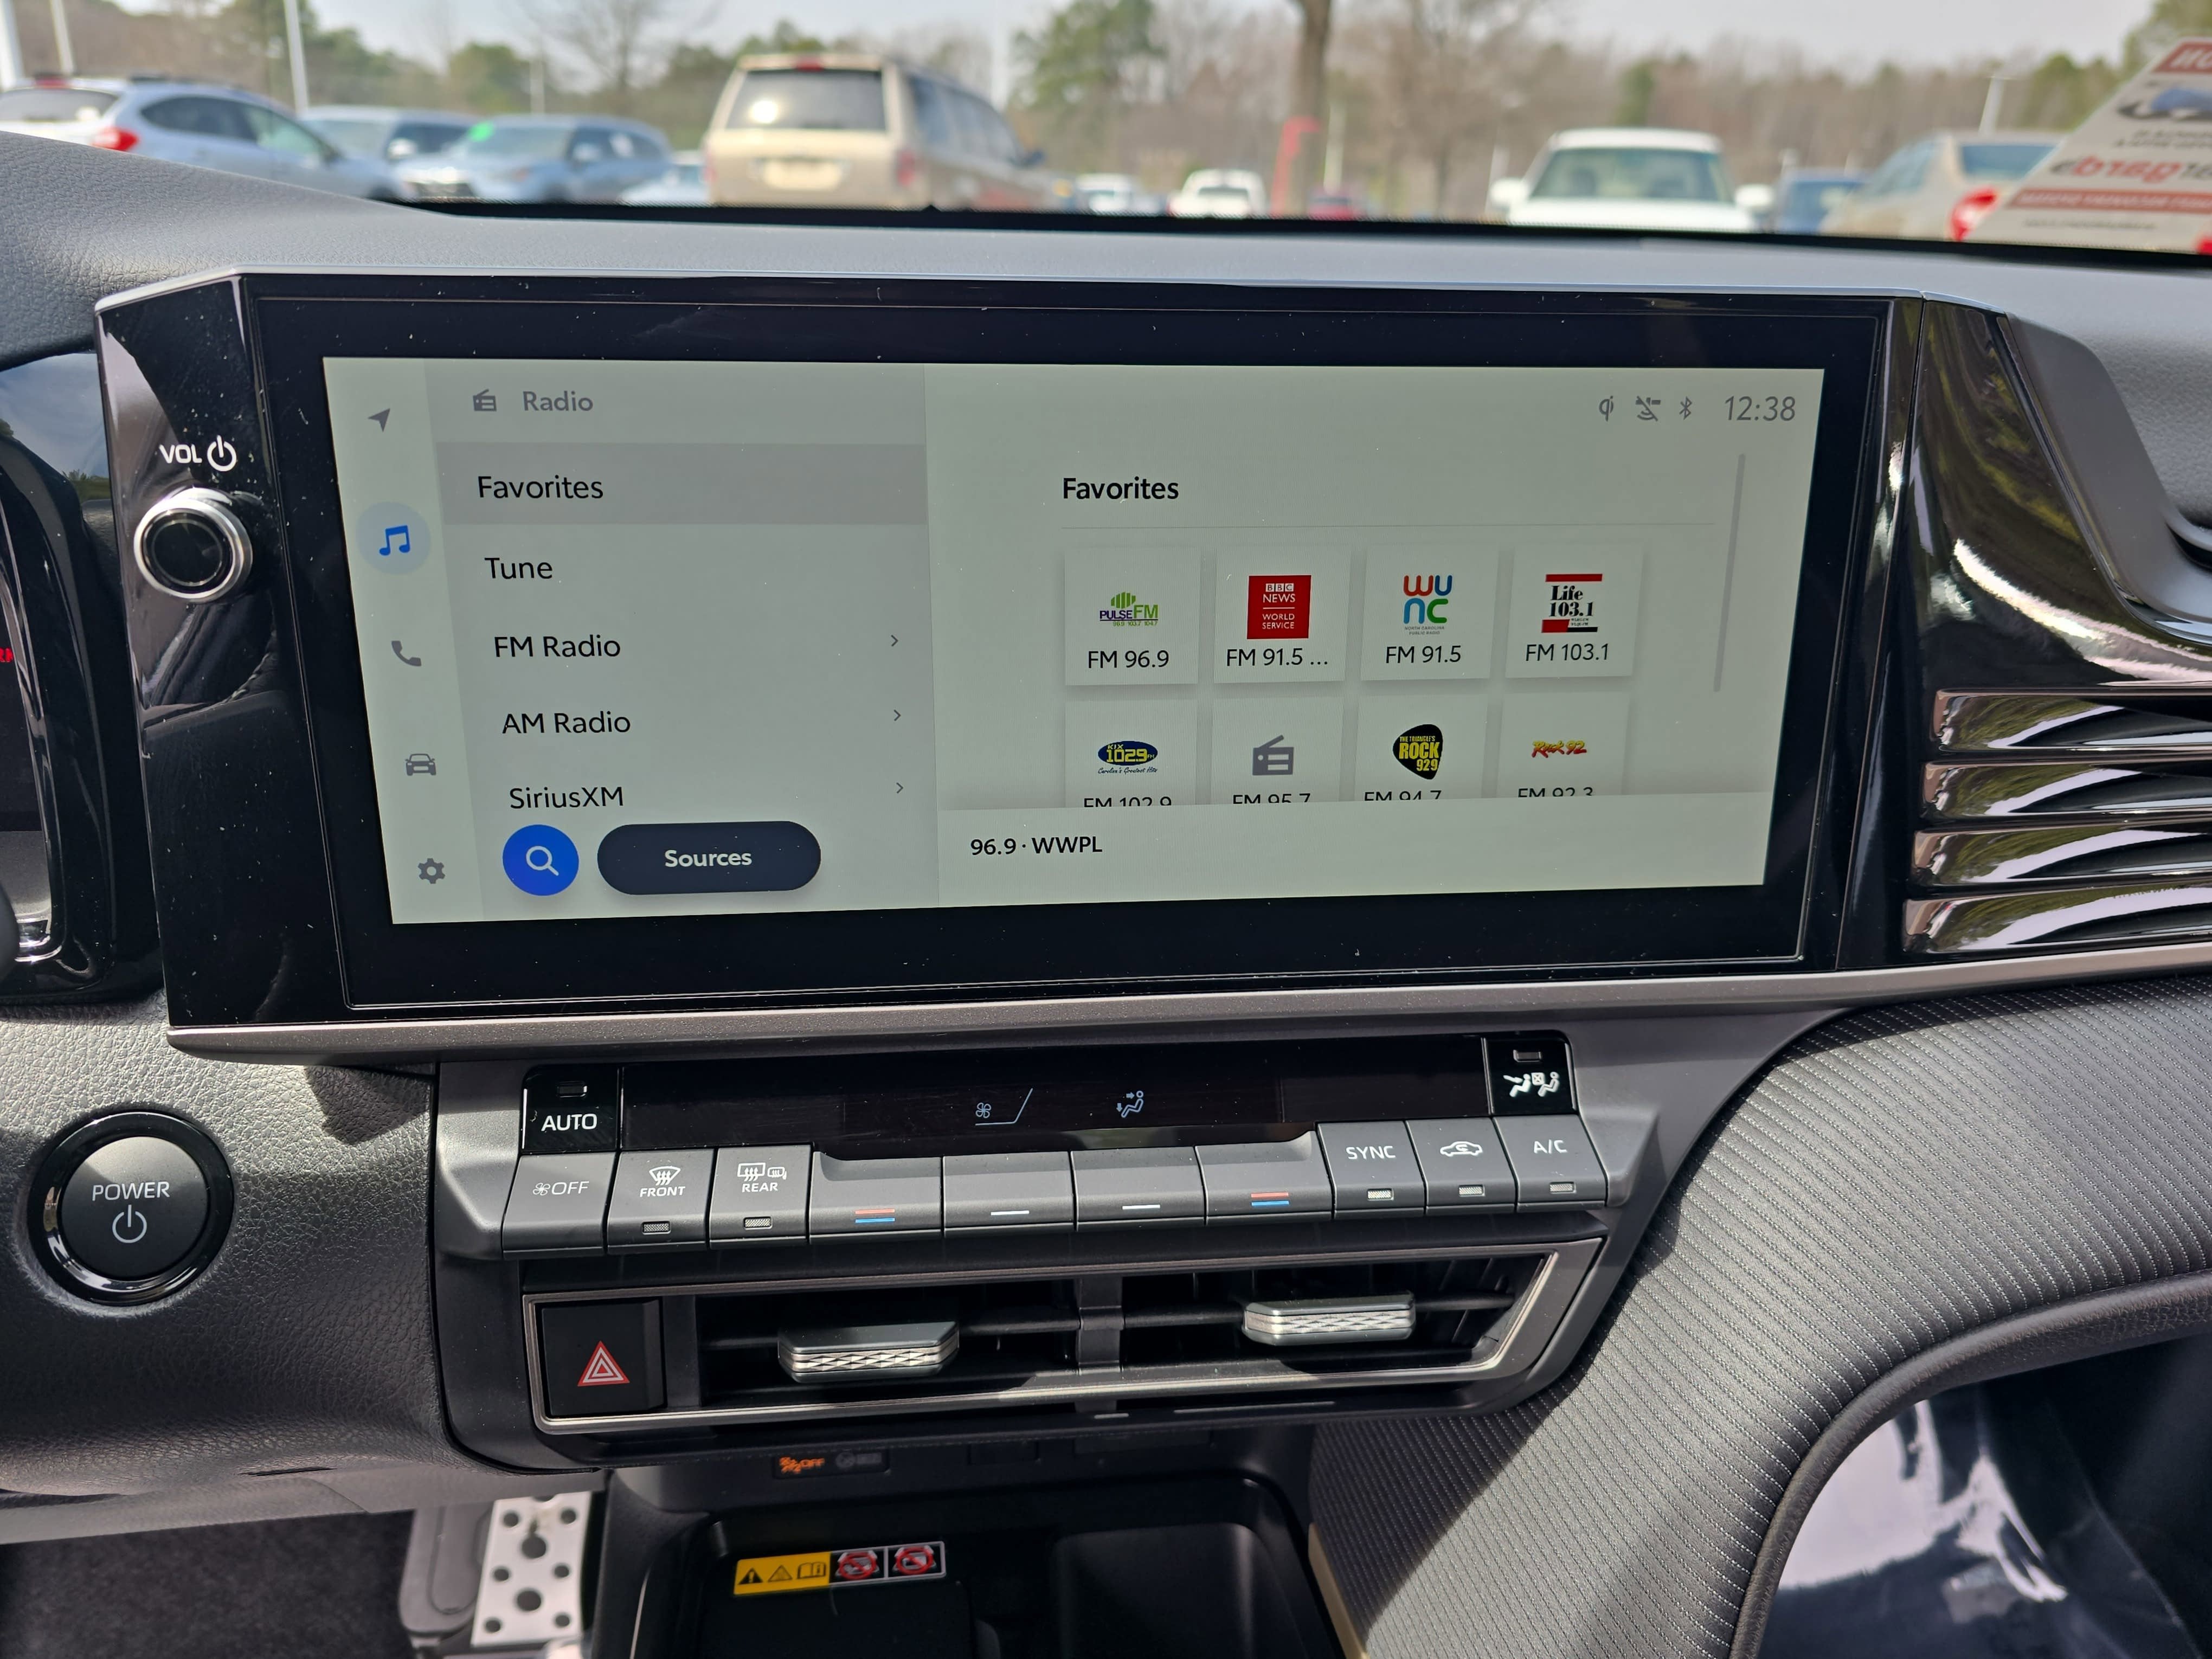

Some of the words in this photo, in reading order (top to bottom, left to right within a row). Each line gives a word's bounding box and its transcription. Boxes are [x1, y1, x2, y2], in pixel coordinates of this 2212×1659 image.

[523, 390, 594, 411] Radio
[1725, 396, 1796, 421] 12:38
[159, 445, 202, 464] VOL
[478, 475, 603, 499] Favorites
[1063, 476, 1179, 500] Favorites
[485, 557, 553, 580] Tune
[1265, 583, 1294, 592] BBC
[1550, 586, 1583, 600] Life
[1263, 594, 1295, 603] NEWS
[1549, 602, 1593, 616] 103.1
[494, 636, 533, 658] FM
[543, 634, 621, 658] Radio
[1386, 646, 1415, 664] FM
[1422, 646, 1461, 663] 91.5
[1526, 644, 1554, 661] FM
[1562, 644, 1608, 661] 103.1
[1088, 651, 1117, 668] FM
[1124, 650, 1169, 667] 96.9
[1227, 649, 1256, 667] FM
[1263, 648, 1303, 666] 91.5
[503, 713, 545, 734] AM
[554, 711, 631, 734] Radio
[1399, 742, 1440, 759] ROCK
[1532, 741, 1565, 758] Rock
[1565, 741, 1587, 755] 92
[510, 786, 623, 809] SiriusXM
[970, 838, 1017, 855] 96.9
[1032, 837, 1103, 853] WWPL
[665, 847, 753, 867] Sources
[542, 1114, 597, 1131] AUTO
[1346, 1145, 1396, 1160] SYNC
[1533, 1140, 1567, 1154] A/C
[92, 1181, 170, 1201] POWER
[551, 1181, 589, 1195] OFF
[640, 1185, 686, 1198] FRONT
[742, 1182, 778, 1193] REAR
